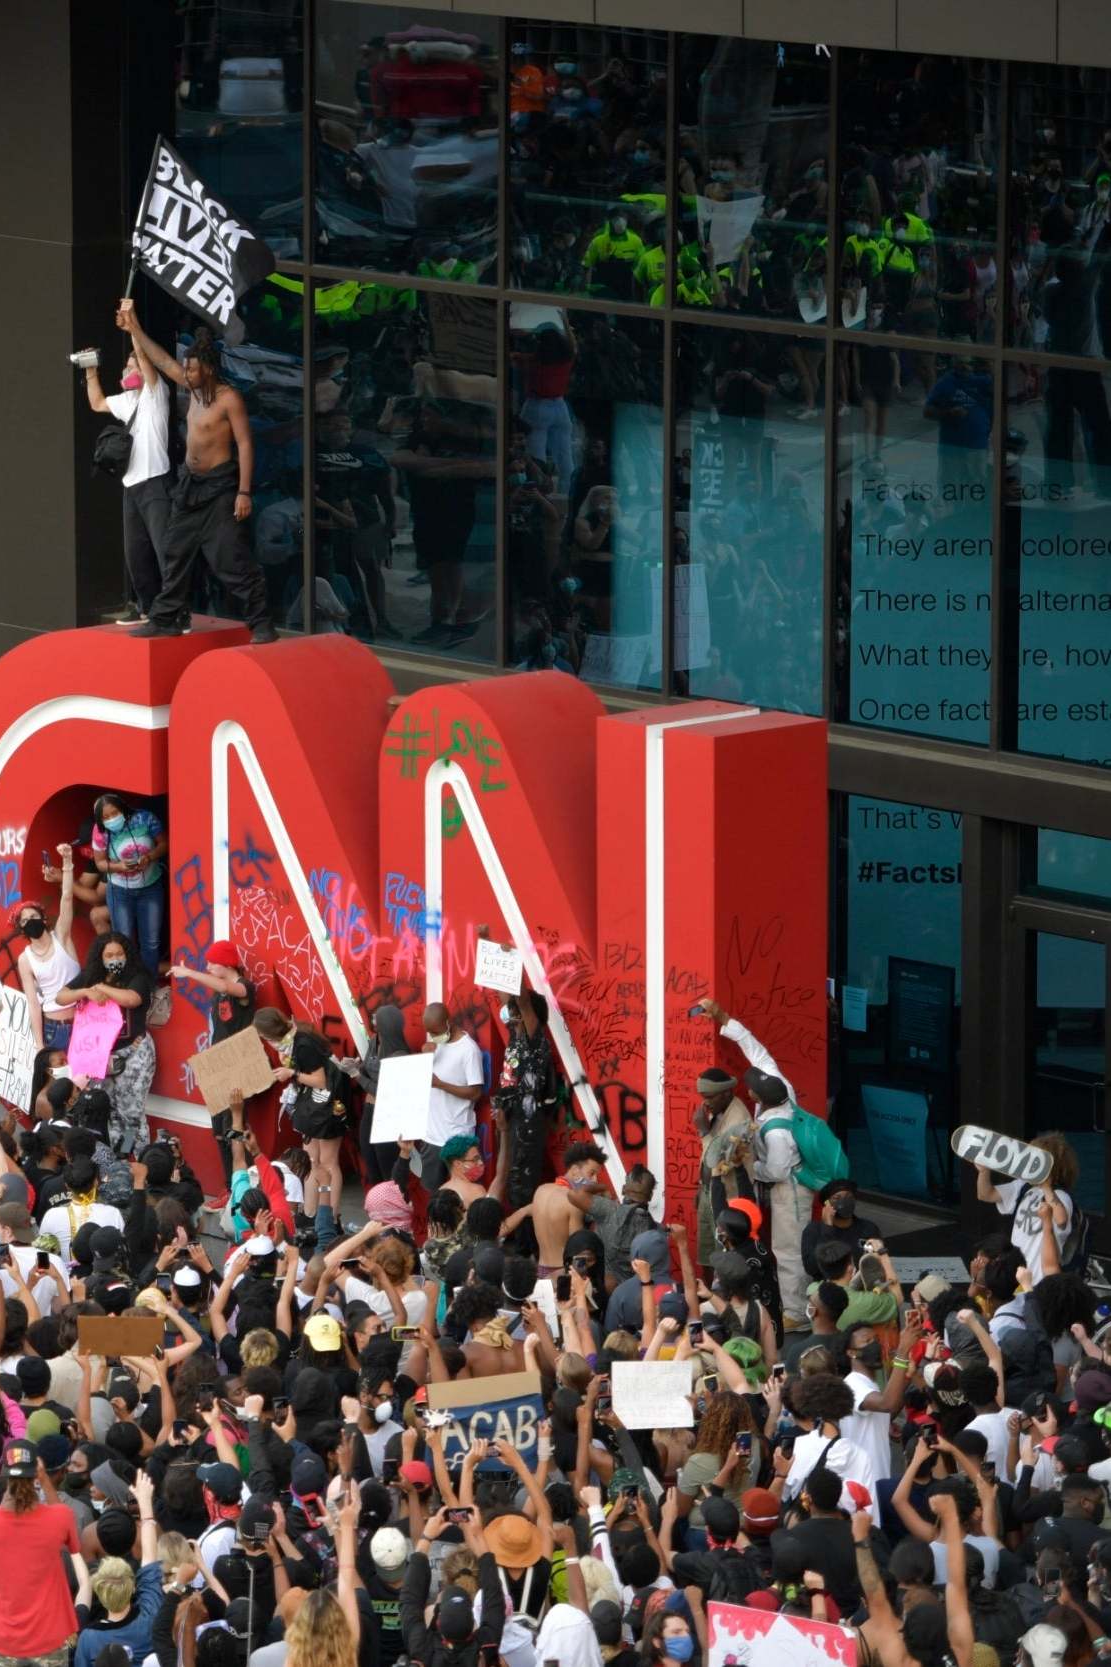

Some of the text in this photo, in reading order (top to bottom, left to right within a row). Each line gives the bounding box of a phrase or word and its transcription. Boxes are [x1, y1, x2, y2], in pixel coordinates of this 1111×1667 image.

[861, 479, 934, 501] Facts
[942, 483, 986, 501] are
[859, 534, 925, 561] They
[1021, 534, 1111, 557] colore
[859, 589, 1111, 612] There is n alterna
[859, 644, 929, 666] What
[939, 645, 992, 671] they
[1022, 648, 1054, 669] re,
[859, 698, 930, 721] Once
[939, 699, 991, 721] fact
[1017, 703, 1058, 721] are
[858, 806, 941, 829] That's
[577, 977, 617, 1004] FUCK
[962, 1127, 1046, 1181] FLOYD
[440, 1404, 540, 1452] ACAB
